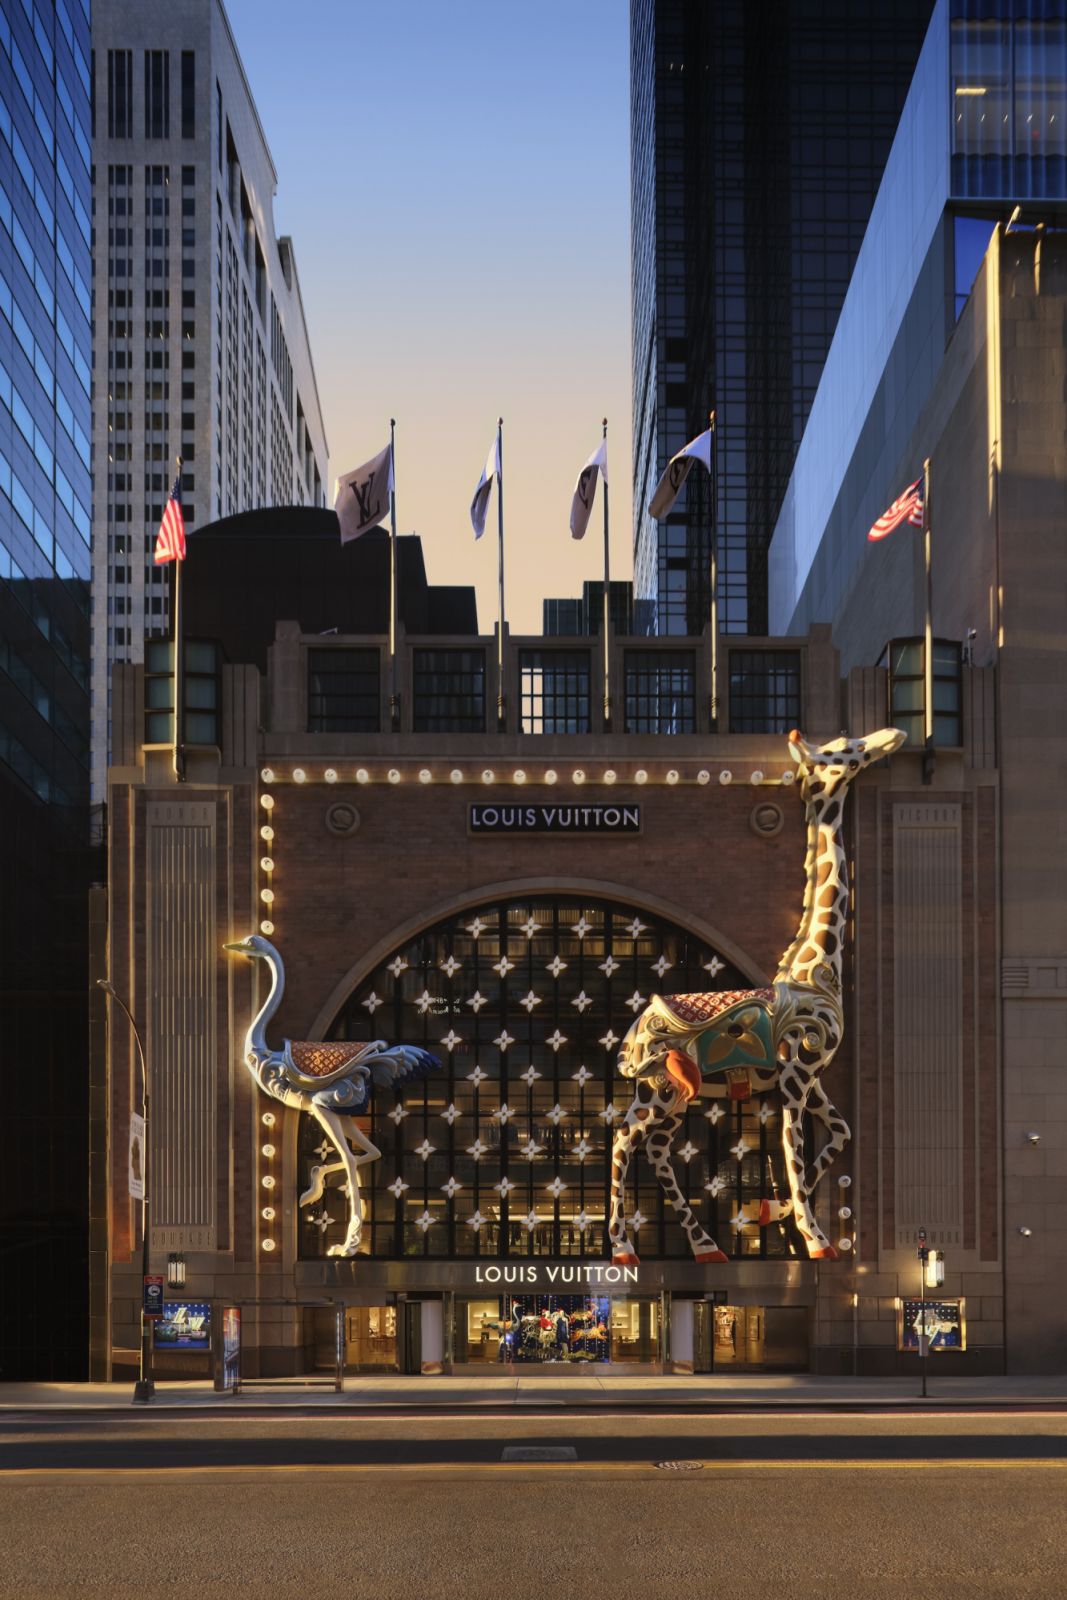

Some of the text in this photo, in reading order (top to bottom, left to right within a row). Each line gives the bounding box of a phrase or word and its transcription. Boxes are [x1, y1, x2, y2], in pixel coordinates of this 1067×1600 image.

[472, 808, 638, 826] LOUIS VUITTON
[900, 808, 956, 821] VICTORY
[152, 1232, 210, 1246] COURAGE
[899, 1231, 959, 1244] TEAWORK
[475, 1266, 638, 1283] LOUIS VUITTON
